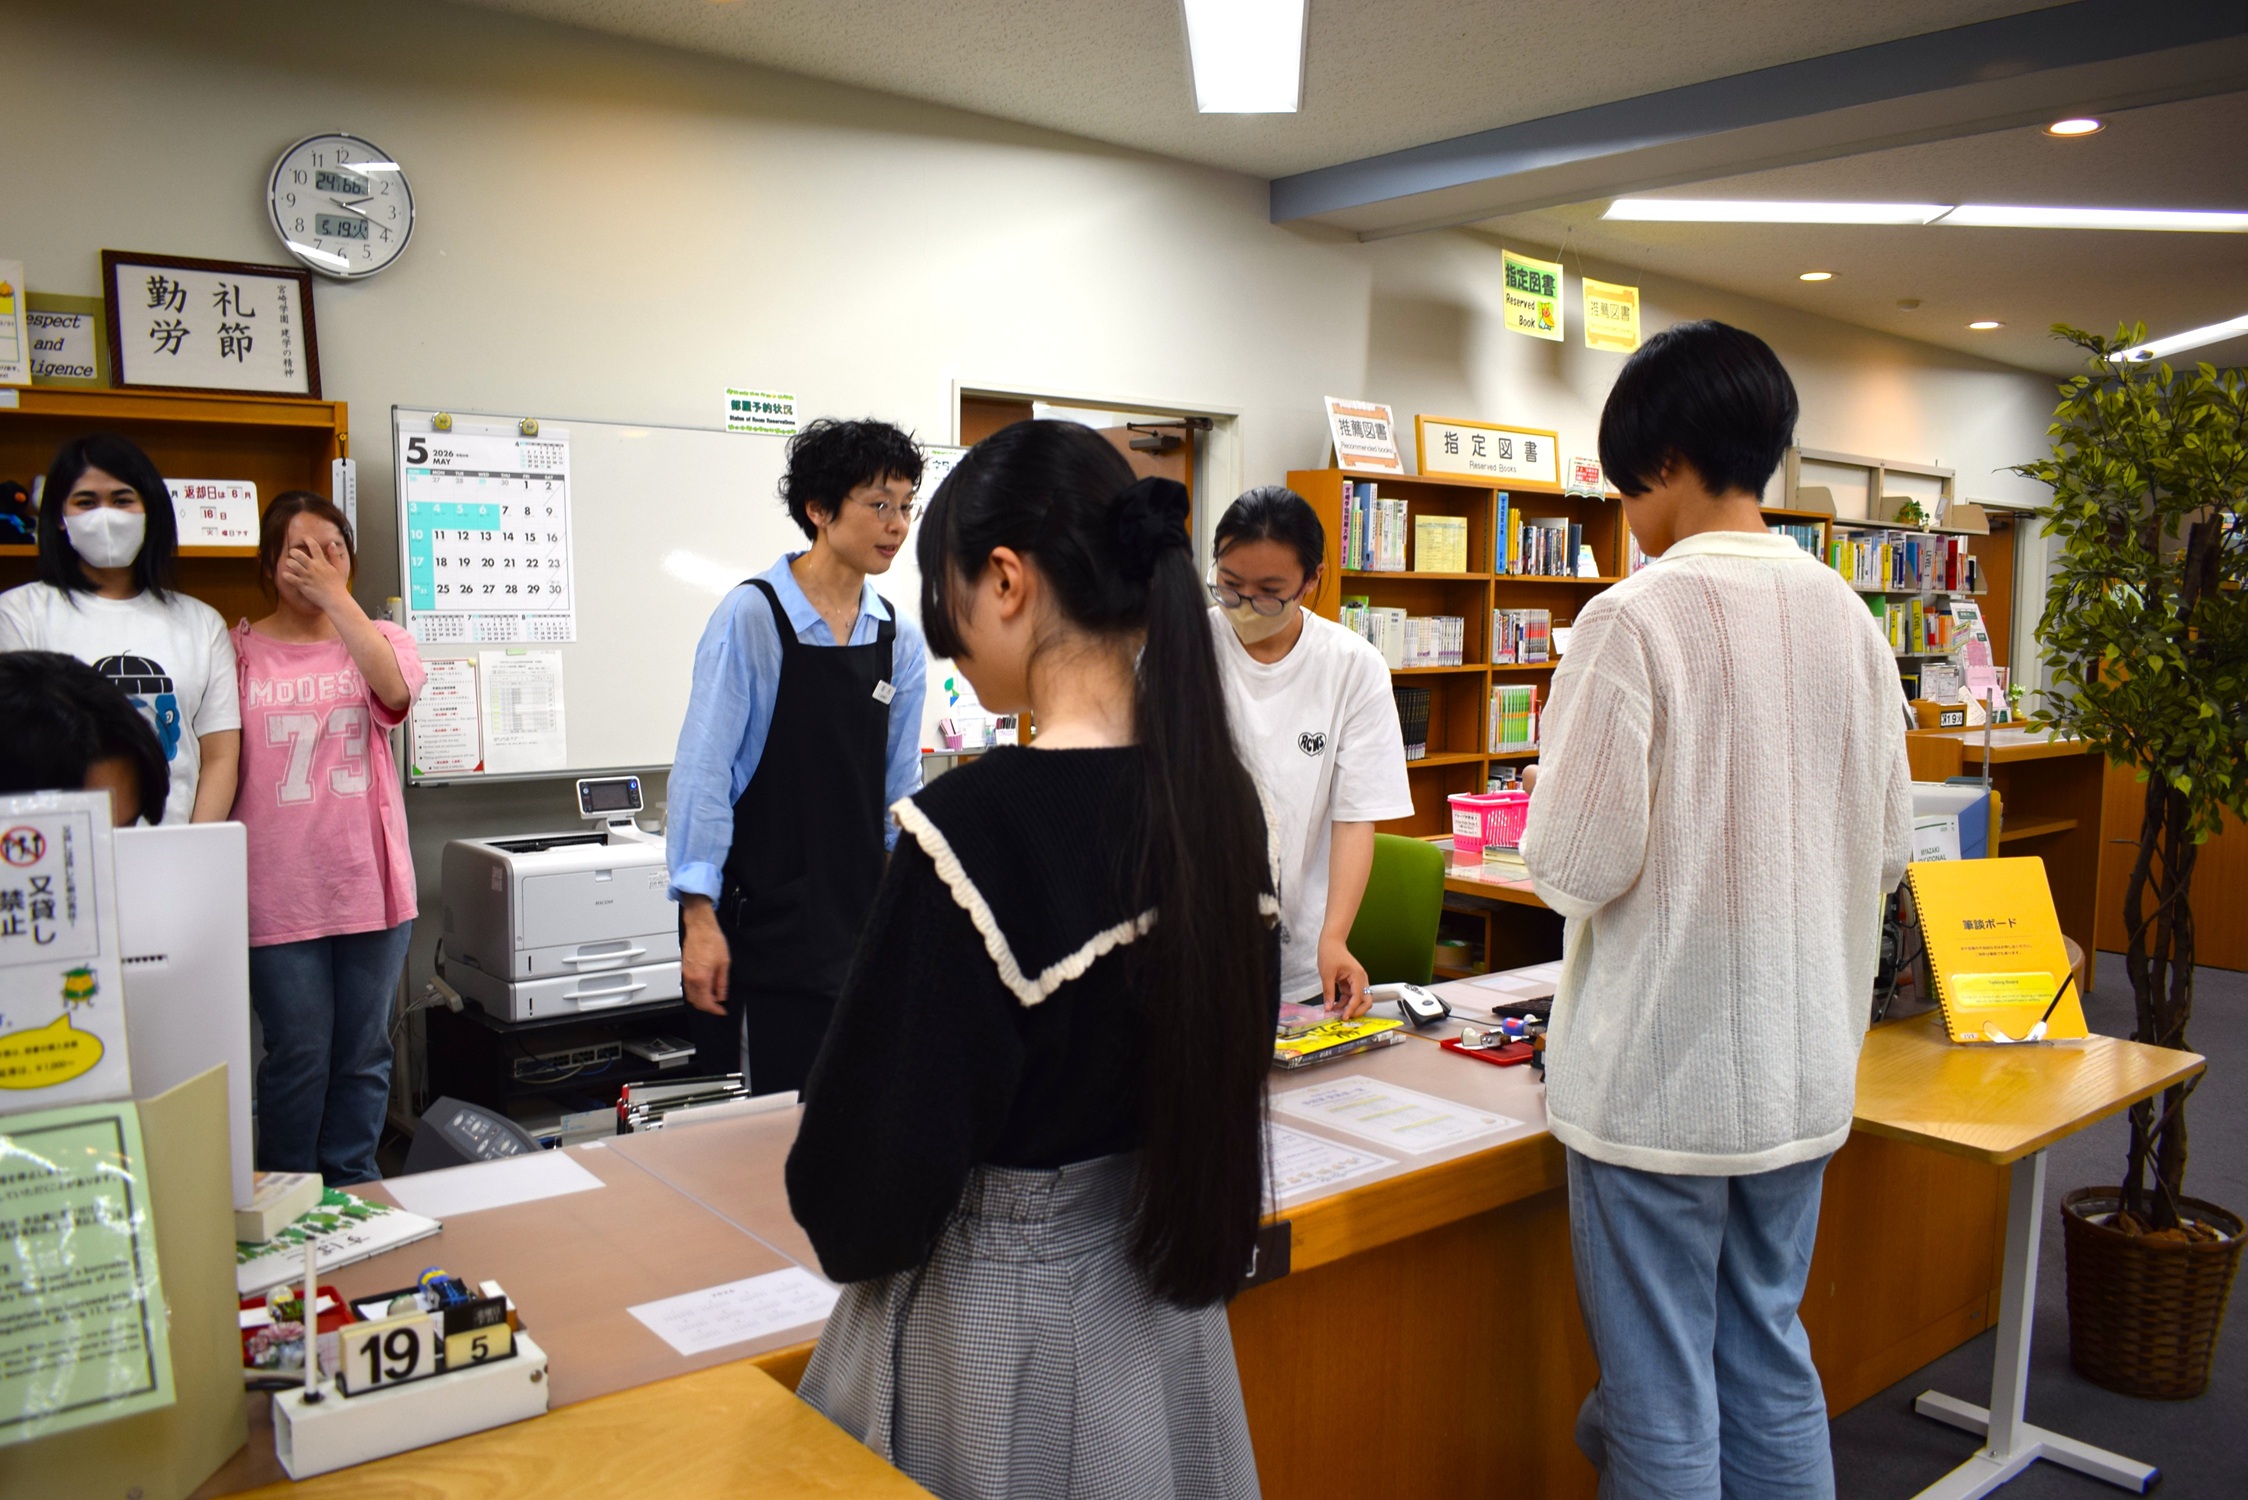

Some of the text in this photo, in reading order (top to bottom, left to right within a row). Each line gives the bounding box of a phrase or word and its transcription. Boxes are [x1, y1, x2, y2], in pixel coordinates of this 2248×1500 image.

[311, 153, 323, 168] 11
[336, 149, 349, 164] 12
[293, 169, 307, 185] 10
[380, 180, 389, 195] 2
[286, 193, 296, 208] 9
[387, 204, 397, 220] 3
[295, 218, 305, 233] 8
[379, 227, 389, 243] 4
[362, 244, 371, 260] 5
[1505, 262, 1556, 298] 指定図書
[1506, 292, 1535, 311] Reserved
[146, 274, 191, 357] 勤労
[212, 281, 256, 364] 礼節
[1519, 314, 1536, 328] Book
[277, 284, 295, 378] 宮崎学園 建学の精神
[34, 338, 65, 352] and
[1338, 417, 1387, 441] 推薦図書
[406, 437, 429, 465] 5
[433, 449, 454, 457] 2026
[1444, 431, 1538, 463] 指定図書
[1469, 460, 1517, 473] Reserved Books
[184, 485, 225, 499] 返却日は
[524, 480, 528, 489] 1
[545, 481, 552, 490] 2
[410, 502, 417, 512] 3
[456, 504, 463, 513] 5
[479, 504, 487, 514] 6
[502, 505, 509, 515] 7
[524, 506, 531, 515] 8
[546, 507, 553, 516] 9
[411, 529, 558, 542] 10 11 12 13 14 15 16
[411, 557, 560, 568] 17 18 19 20 21 22 23
[436, 584, 450, 594] 25
[460, 584, 473, 594] 26
[482, 584, 495, 594] 27
[505, 585, 518, 594] 28
[527, 585, 540, 594] 29
[549, 585, 561, 594] 30
[1913, 612, 1921, 632] LEVEL
[265, 705, 374, 807] 73
[0, 889, 26, 937] 禁止
[29, 876, 56, 945] 又貸し
[1962, 918, 2017, 930] 筆談ボード
[359, 1327, 489, 1385] 19 5
